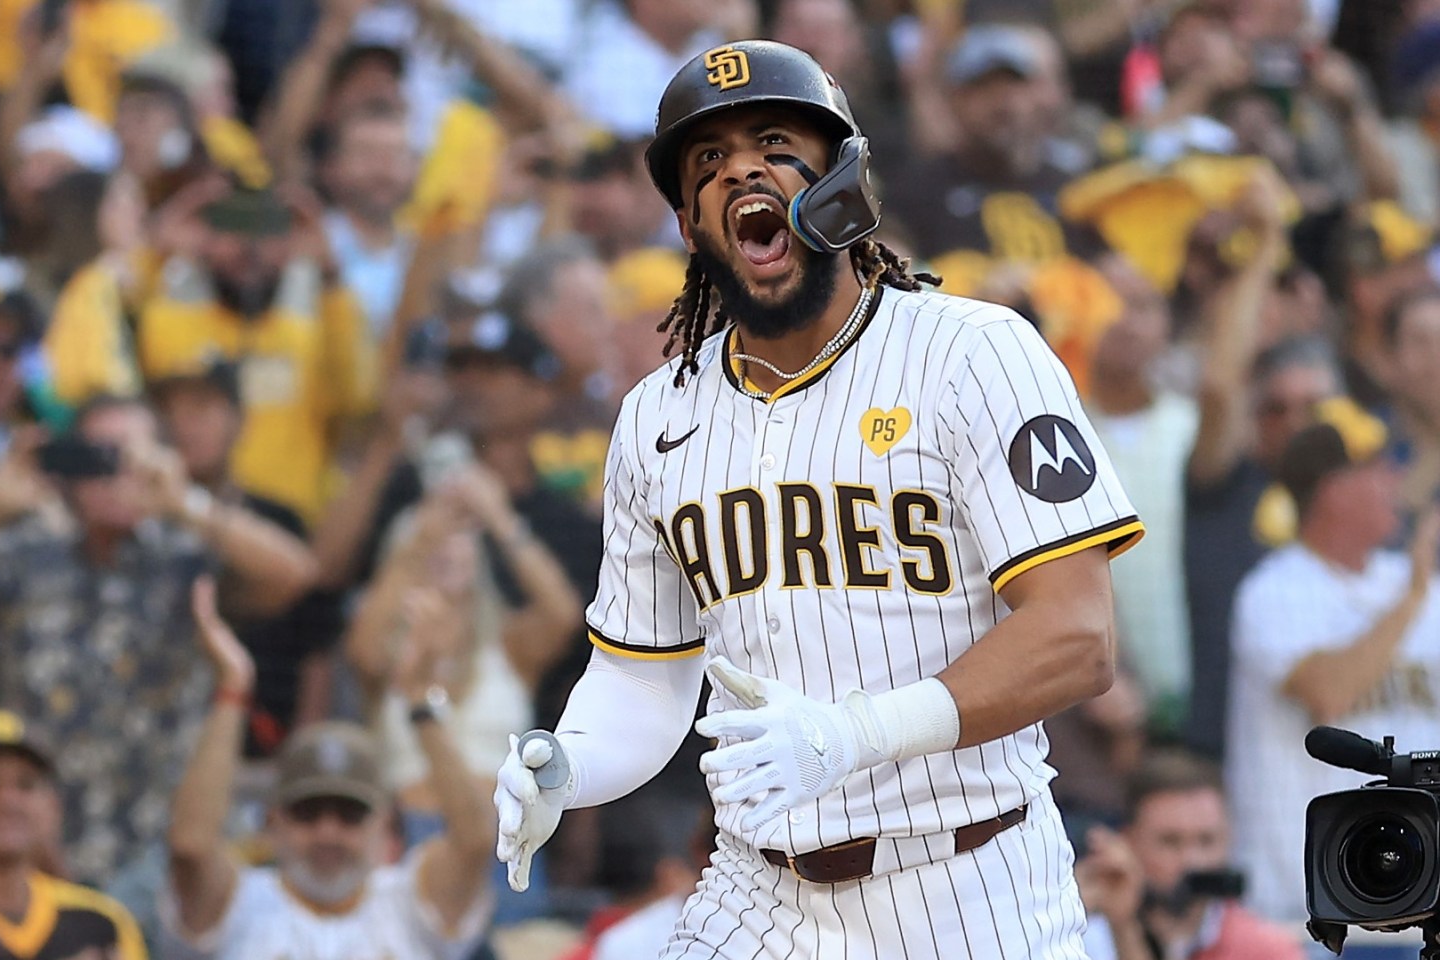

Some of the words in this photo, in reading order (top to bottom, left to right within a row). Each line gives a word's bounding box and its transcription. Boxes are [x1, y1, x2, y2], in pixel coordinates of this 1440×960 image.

[704, 46, 750, 90] SD
[870, 417, 896, 442] PS
[654, 480, 953, 614] ADRES
[1411, 751, 1438, 760] SONY
